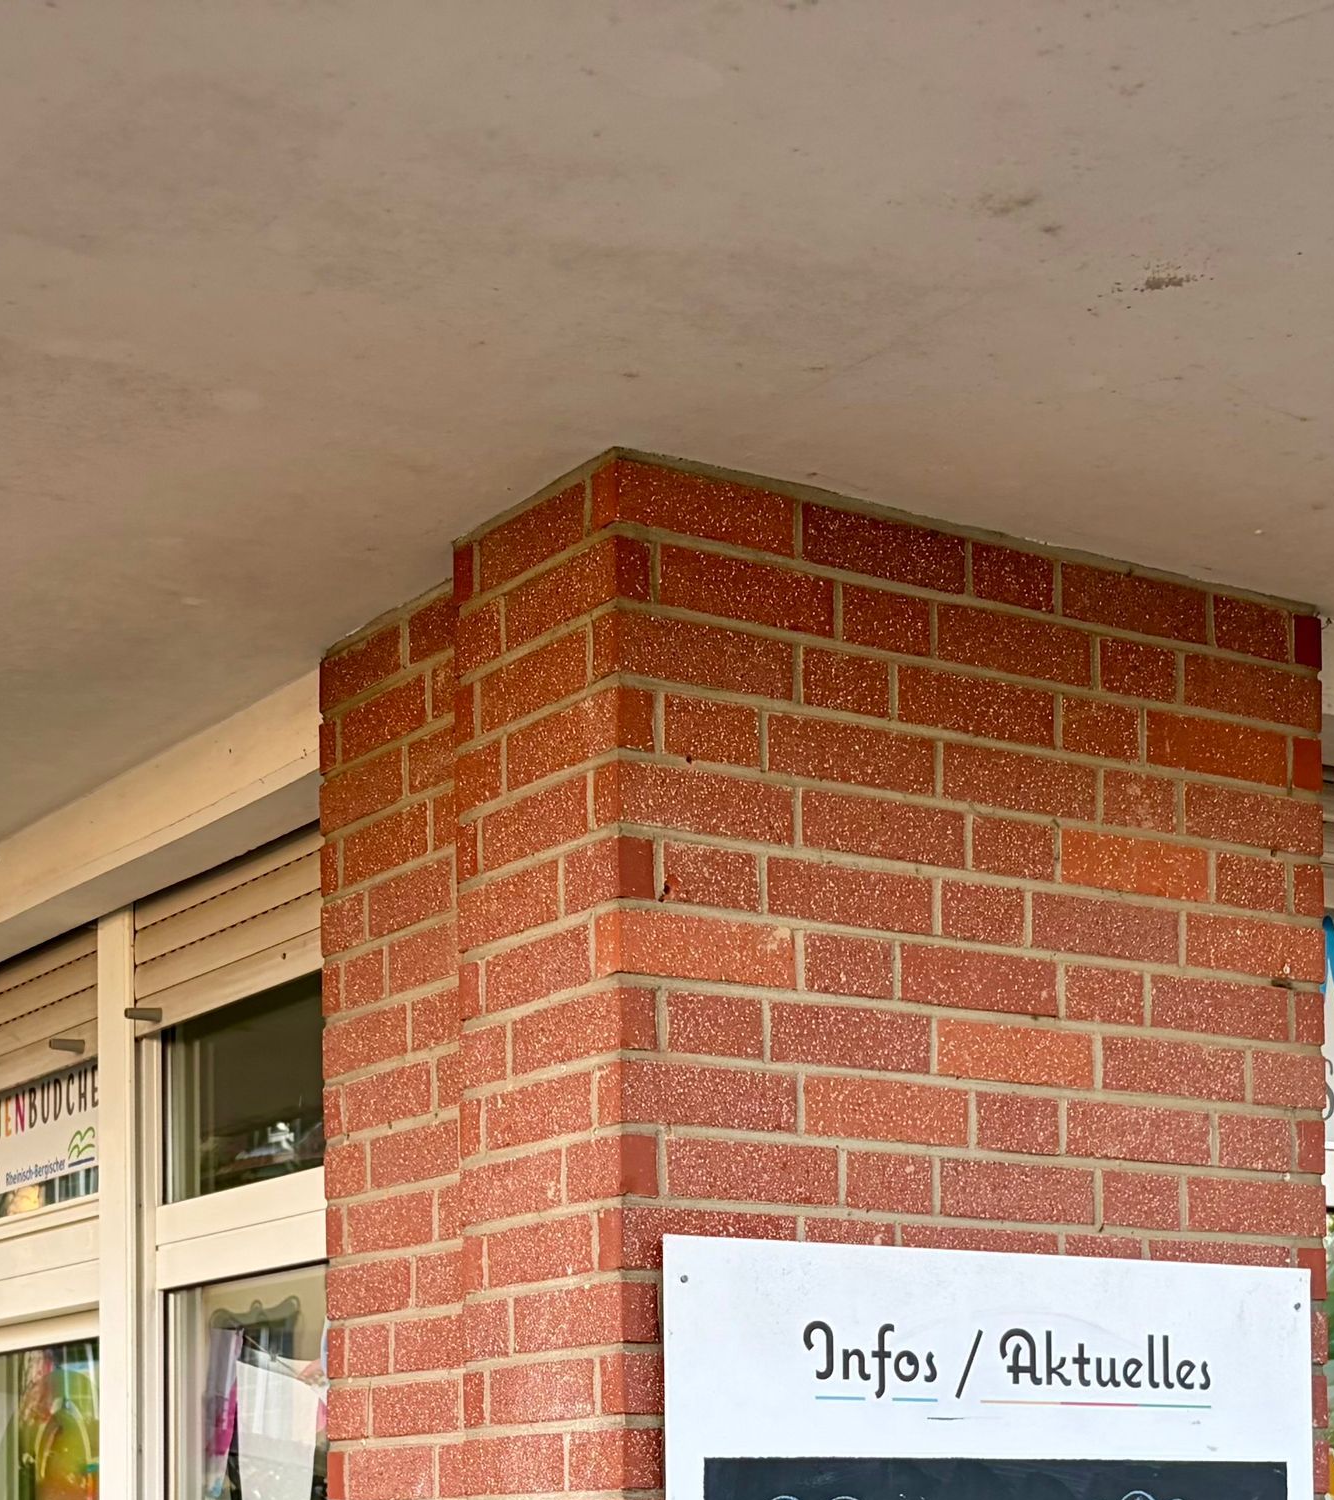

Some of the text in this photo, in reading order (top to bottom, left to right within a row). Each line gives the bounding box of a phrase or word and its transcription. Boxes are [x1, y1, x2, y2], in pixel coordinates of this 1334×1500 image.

[6, 1157, 65, 1187] Rheinisch-Bergischer
[803, 1320, 938, 1399] Infos
[1000, 1328, 1212, 1391] Aktuelles
